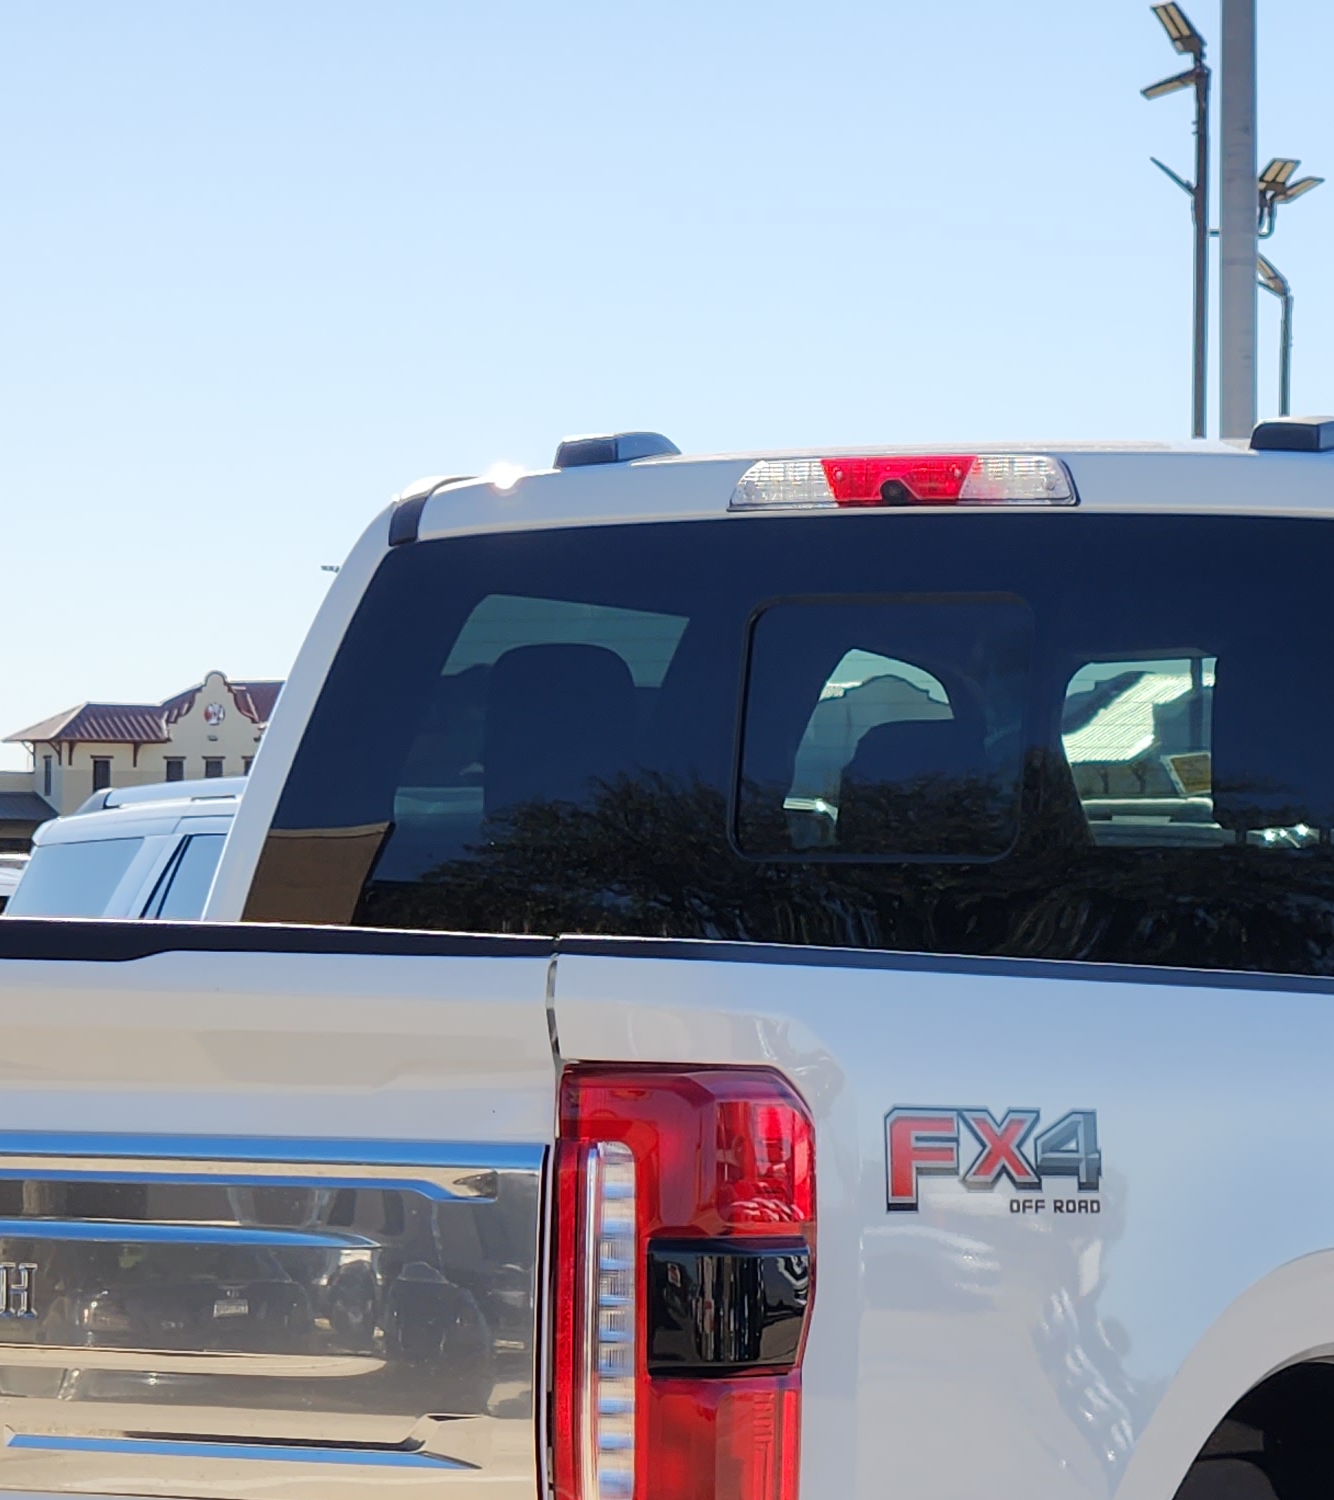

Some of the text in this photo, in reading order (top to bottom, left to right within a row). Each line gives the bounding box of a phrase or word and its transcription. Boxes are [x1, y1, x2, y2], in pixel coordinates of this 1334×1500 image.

[883, 1103, 1103, 1214] FX4
[1009, 1199, 1102, 1214] OFF ROAD
